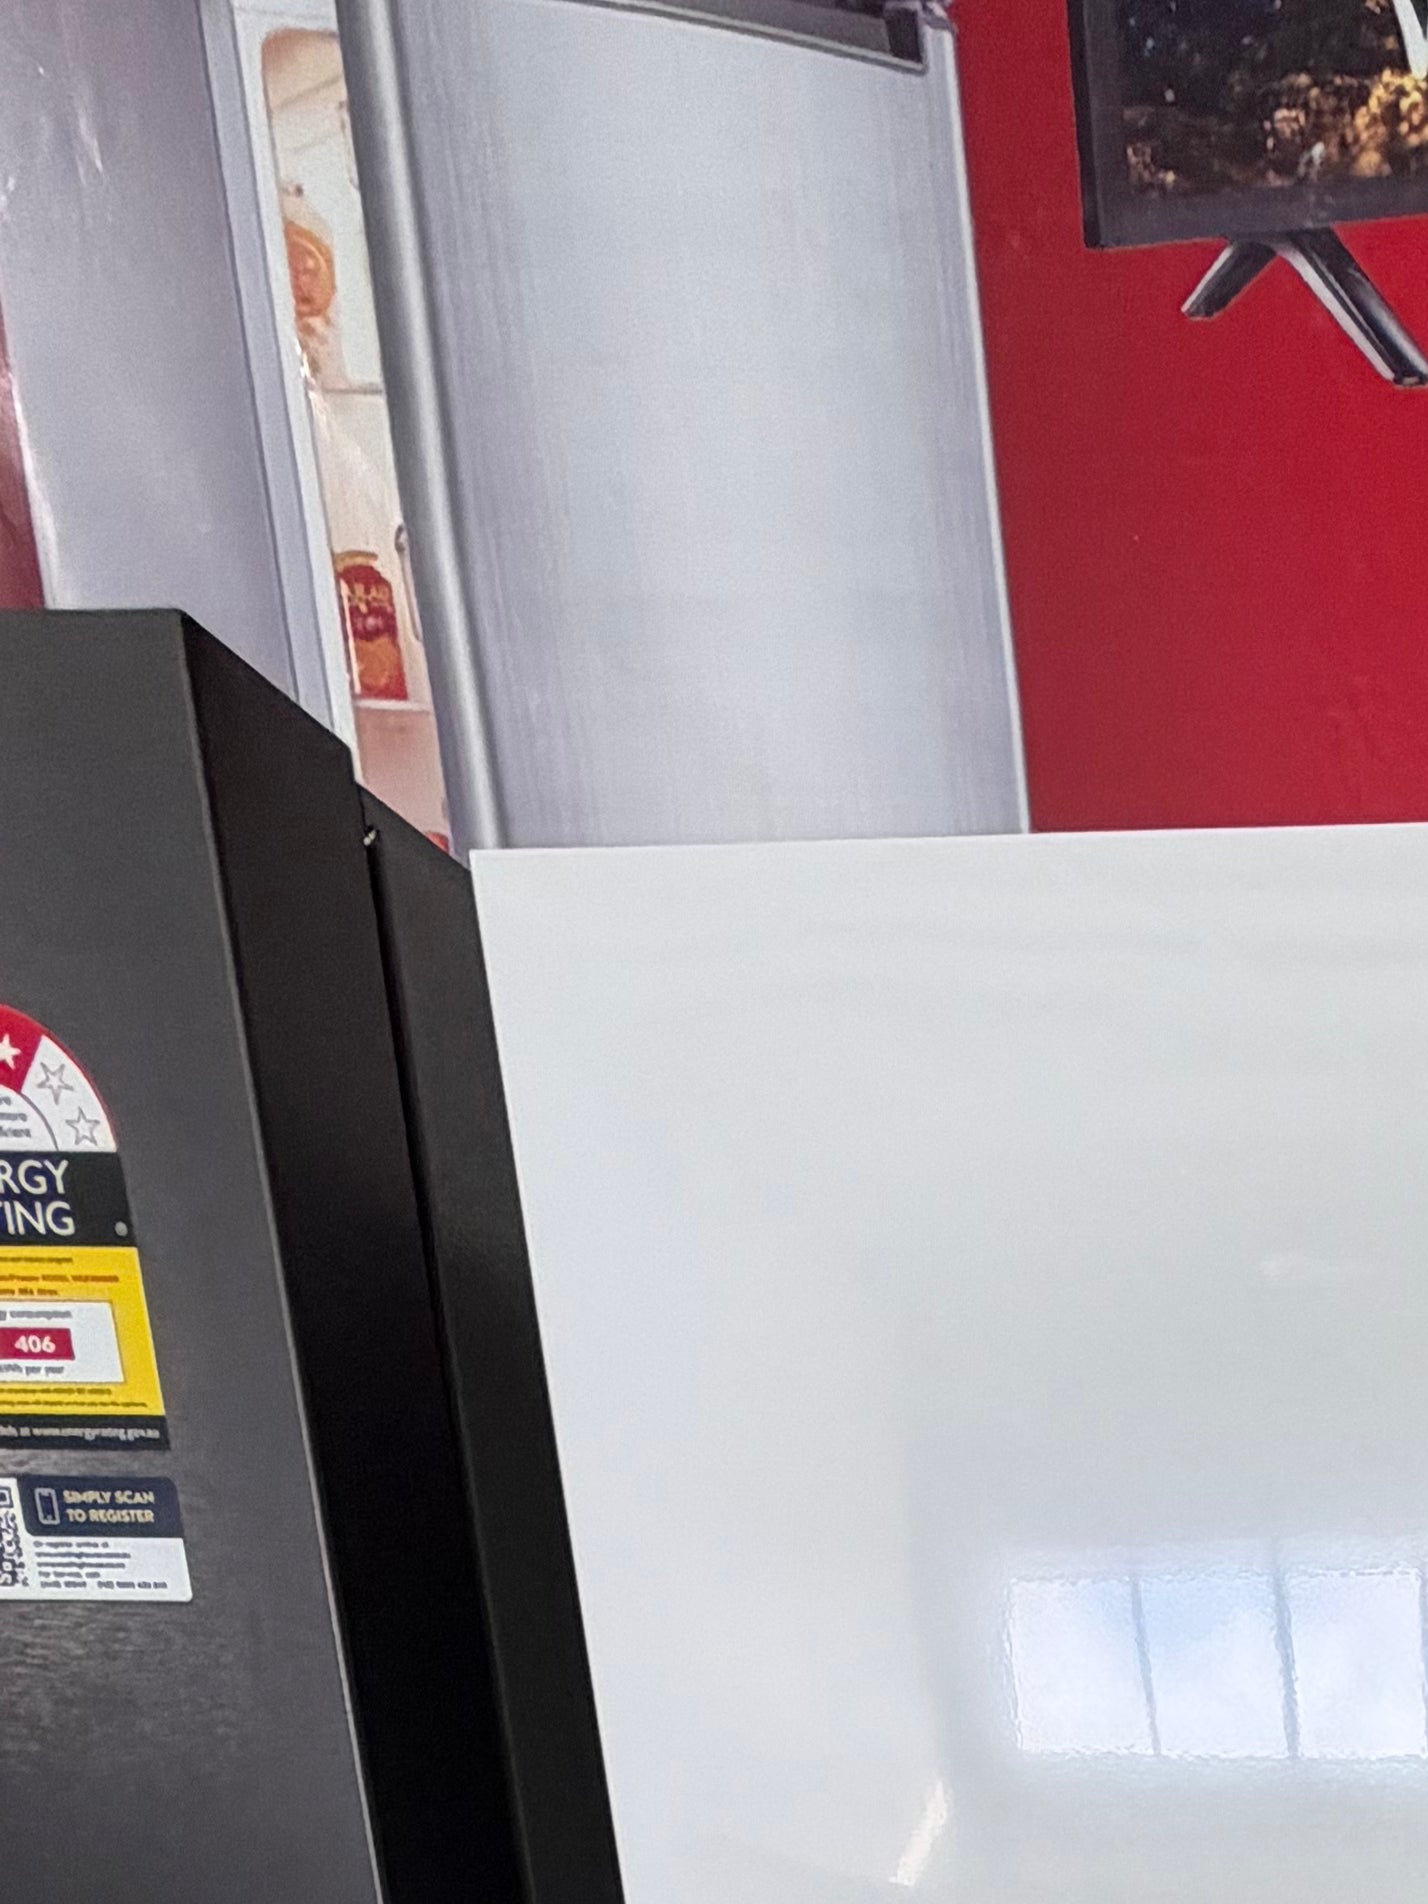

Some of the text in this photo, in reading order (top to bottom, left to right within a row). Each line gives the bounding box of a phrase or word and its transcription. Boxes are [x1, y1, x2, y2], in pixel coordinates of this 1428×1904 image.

[0, 1201, 75, 1236] ING
[14, 1335, 56, 1353] 406
[115, 1491, 155, 1504] SCAN
[66, 1510, 86, 1523] TO
